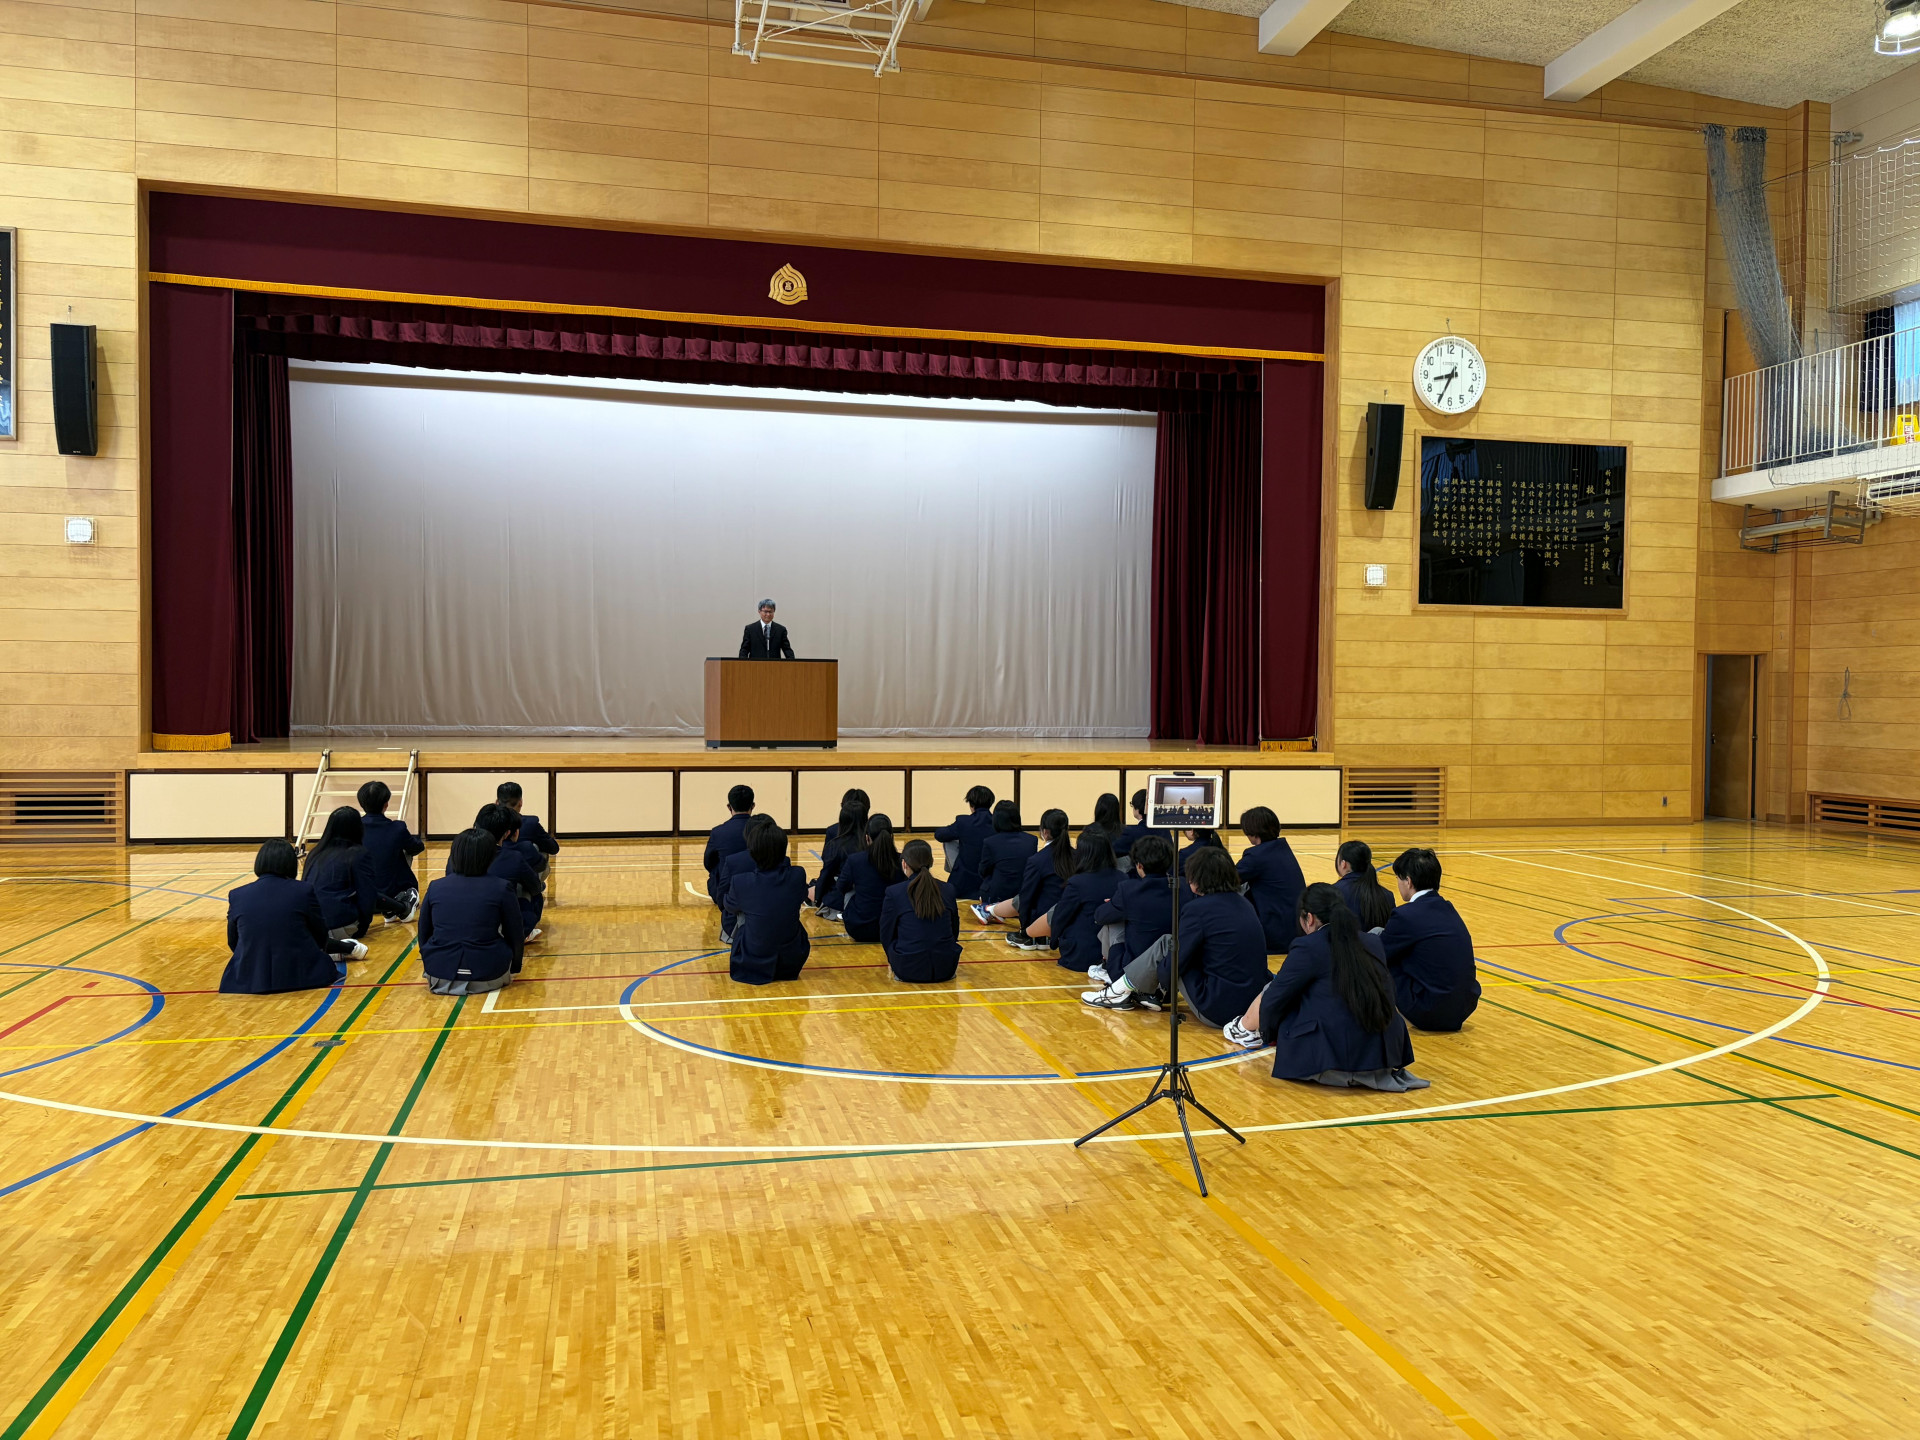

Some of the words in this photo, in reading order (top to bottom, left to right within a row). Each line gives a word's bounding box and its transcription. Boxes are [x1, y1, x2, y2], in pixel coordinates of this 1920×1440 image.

[1437, 348, 1442, 356] 11
[1447, 345, 1454, 354] 12
[1461, 349, 1464, 358] 1
[1427, 357, 1434, 365] 10
[1468, 359, 1473, 368] 2
[1424, 370, 1428, 379] 9
[1472, 373, 1477, 381] 3
[1427, 383, 1432, 392] 8
[1468, 385, 1474, 393] 4
[1447, 397, 1452, 406] 6
[1459, 395, 1464, 404] 5
